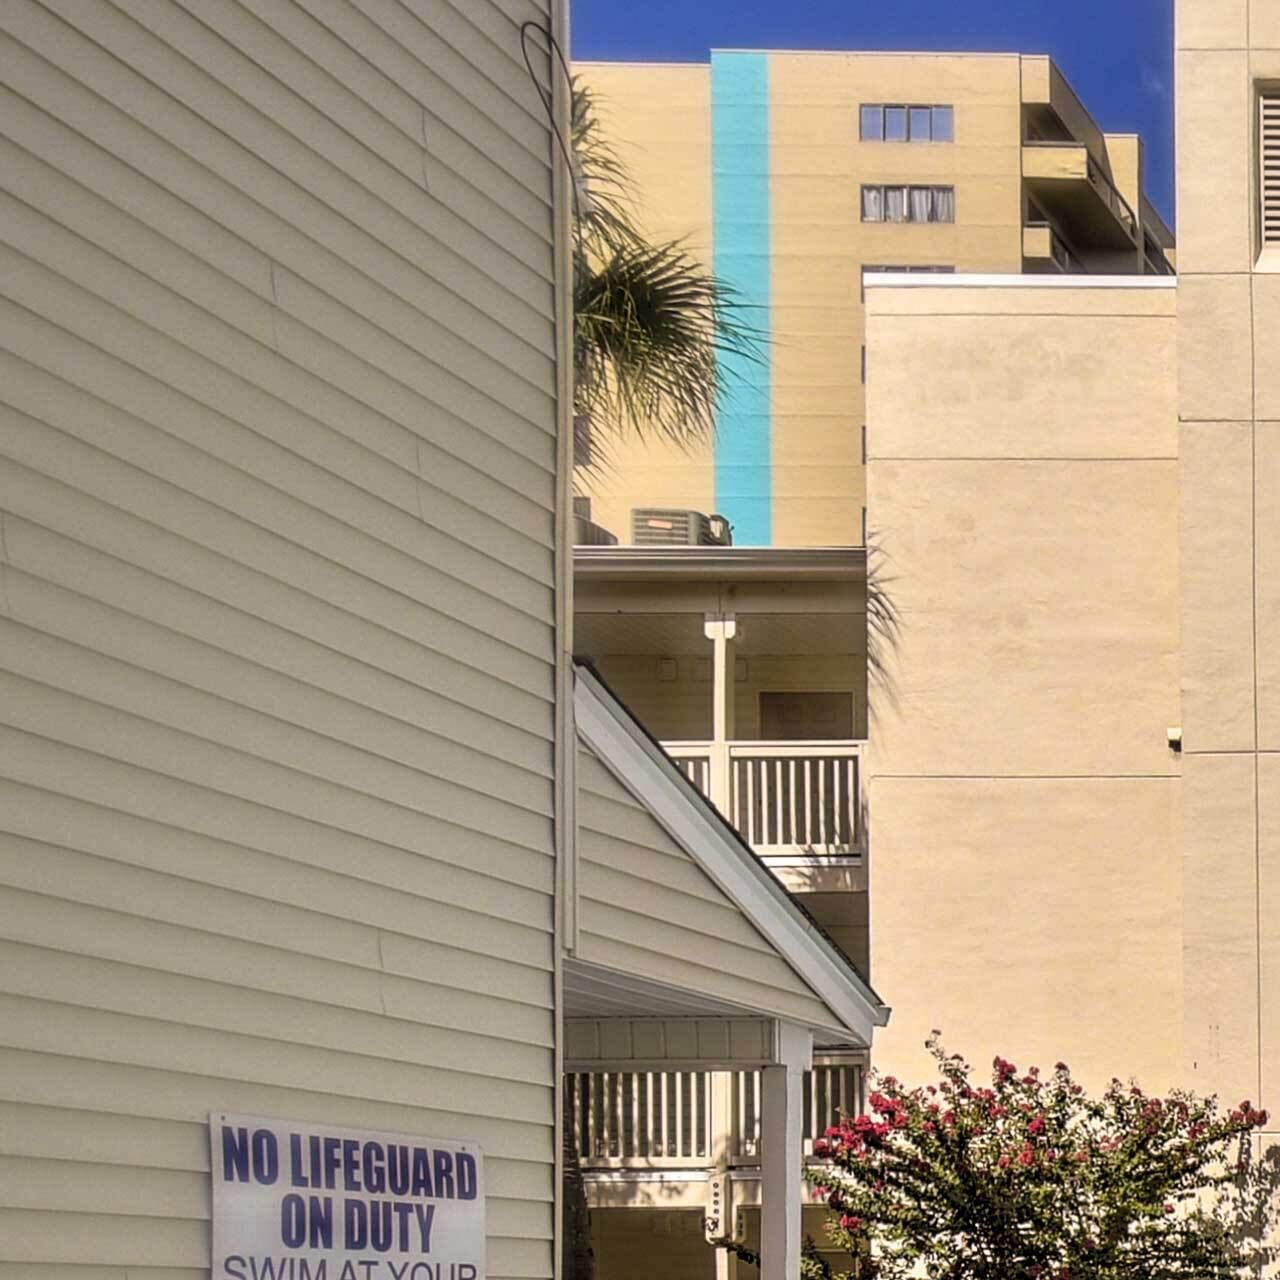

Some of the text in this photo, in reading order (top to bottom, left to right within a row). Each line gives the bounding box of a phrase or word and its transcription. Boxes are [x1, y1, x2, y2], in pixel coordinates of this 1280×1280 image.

[222, 1126, 477, 1200] NO LIFEGUARD
[281, 1193, 435, 1253] ON DUTY
